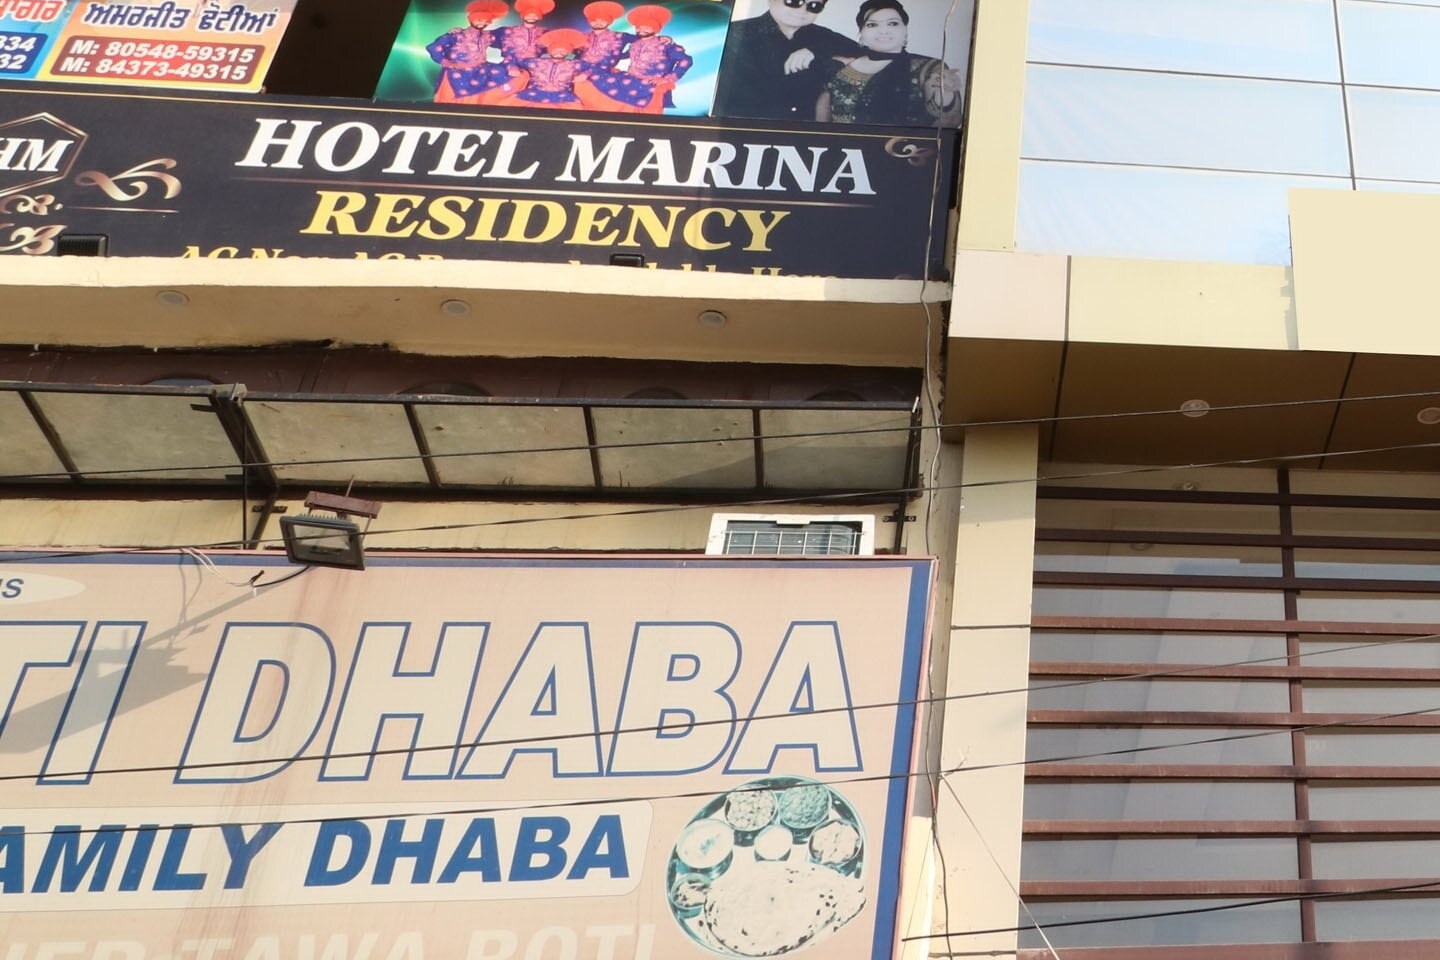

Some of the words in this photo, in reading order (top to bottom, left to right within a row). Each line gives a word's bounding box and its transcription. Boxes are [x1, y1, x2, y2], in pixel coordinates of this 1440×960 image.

[84, 0, 191, 30] ਅਮਰਜੀਤ
[61, 57, 89, 73] M:
[95, 59, 249, 81] 84373-49315
[70, 39, 98, 55] M:
[105, 41, 256, 63] 80548-59315
[235, 117, 540, 181] HOTEL
[555, 134, 877, 195] MARINA
[300, 190, 791, 252] RESIDENCY
[172, 620, 864, 785] DHABA
[303, 814, 630, 887] DHABA
